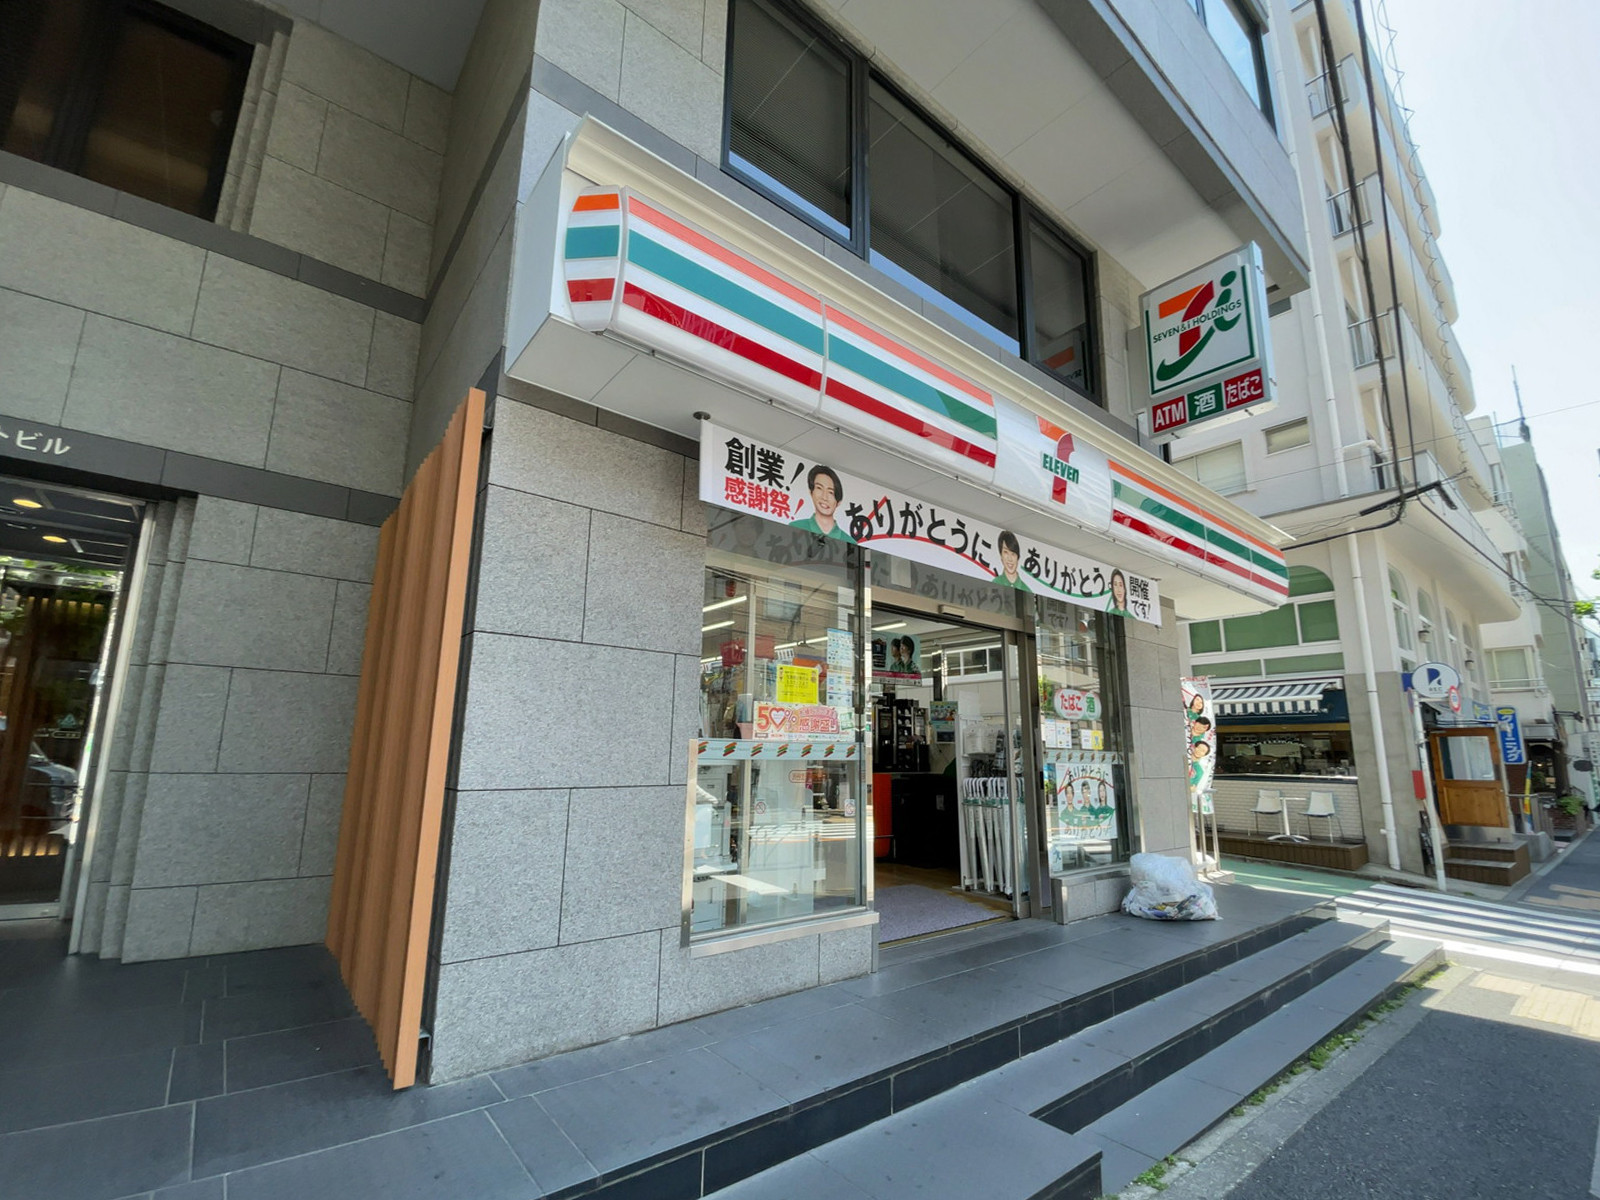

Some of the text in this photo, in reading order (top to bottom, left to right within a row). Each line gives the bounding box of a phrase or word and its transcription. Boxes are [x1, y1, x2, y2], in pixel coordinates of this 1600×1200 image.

[1193, 300, 1242, 327] HOLDINGS
[1194, 389, 1216, 416] 酒
[1226, 376, 1262, 404] たばこ
[1154, 401, 1185, 429] ATM
[725, 437, 805, 491] 創業!
[724, 476, 804, 521] 感謝祭!
[1129, 575, 1150, 601] 開催
[1131, 600, 1151, 620] です!
[1060, 692, 1083, 711] たばこ
[1085, 695, 1096, 713] 酒
